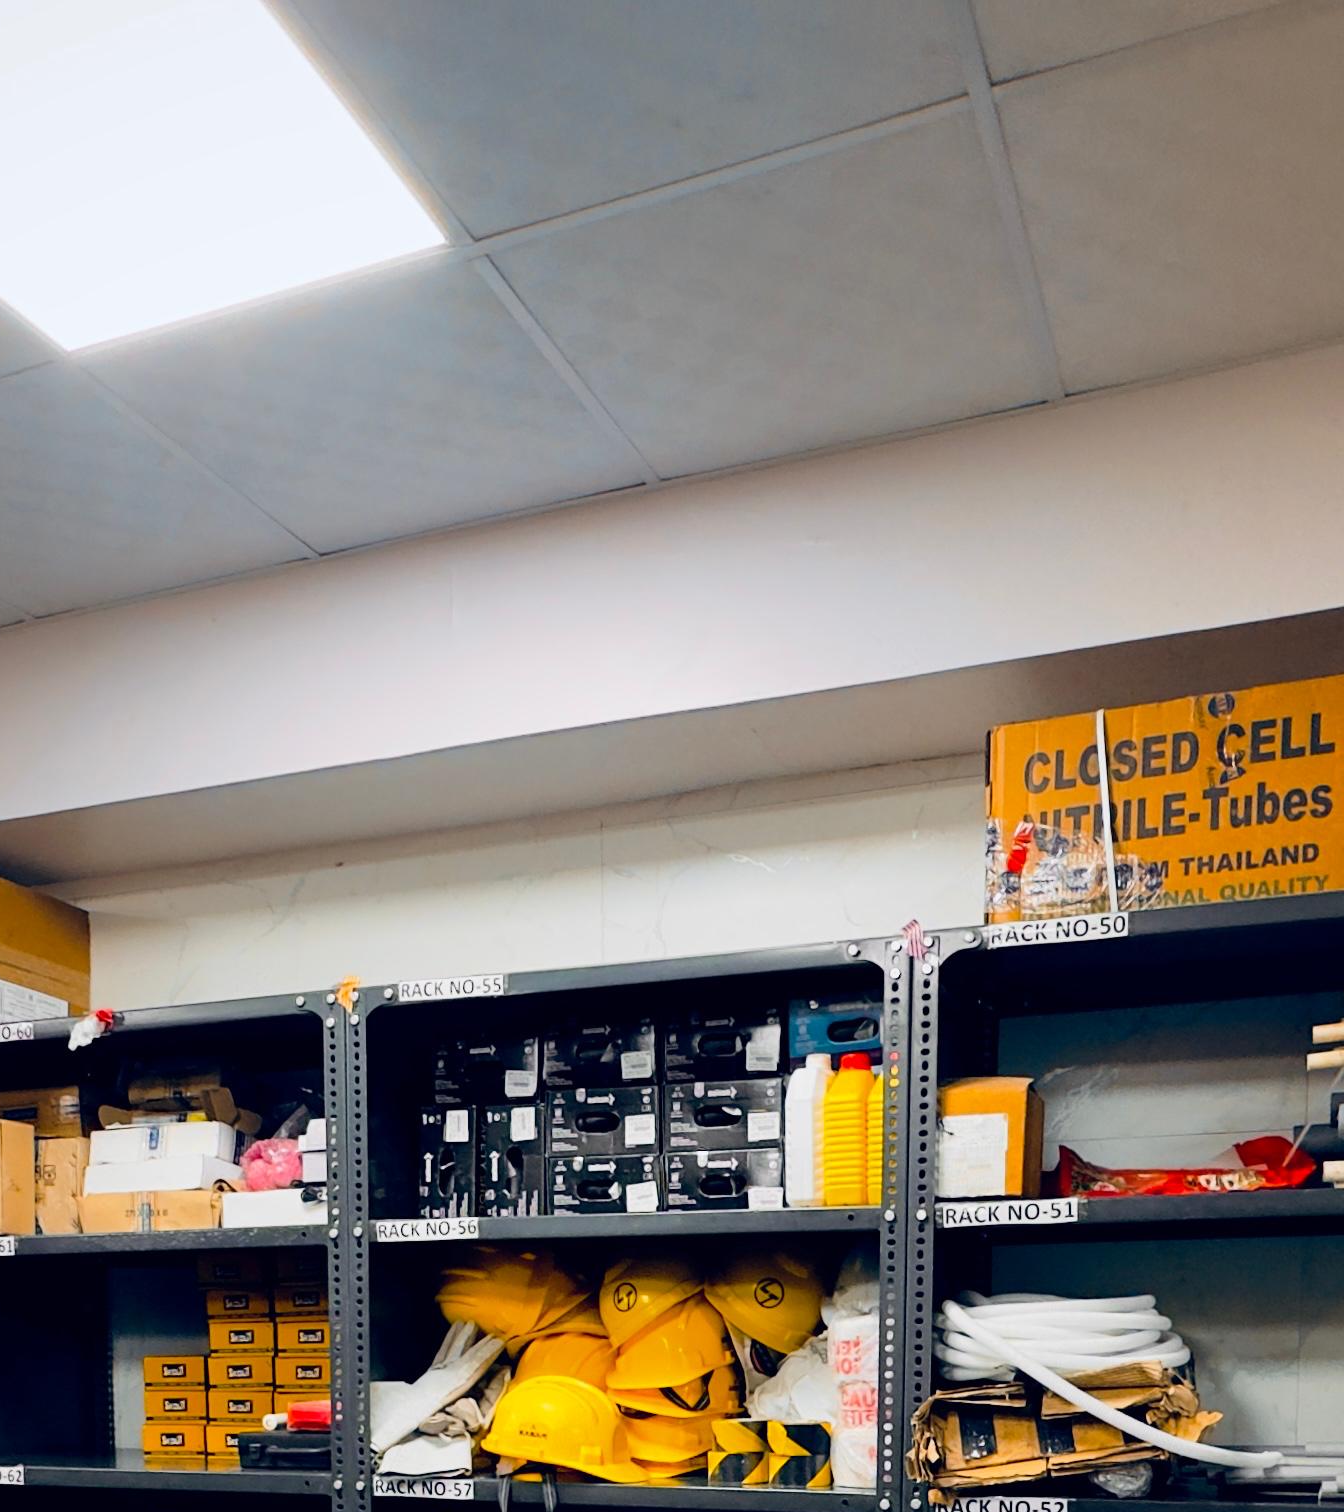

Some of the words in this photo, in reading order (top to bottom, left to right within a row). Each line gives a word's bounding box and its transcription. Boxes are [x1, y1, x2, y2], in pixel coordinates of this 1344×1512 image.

[1024, 731, 1199, 794] CLOSED
[1216, 712, 1336, 767] CELL
[1179, 843, 1320, 876] THAILAND
[1219, 874, 1330, 902] QUALITY
[991, 920, 1046, 945] RACK
[1056, 916, 1126, 940] NO-50
[401, 981, 443, 999] RACK
[449, 977, 501, 995] NO-55
[945, 1204, 999, 1224] RACK
[1008, 1201, 1075, 1220] NO-51
[377, 1222, 420, 1239] RACK
[426, 1218, 477, 1236] NO-56
[374, 1480, 416, 1495] RACK
[423, 1481, 473, 1497] NO-57
